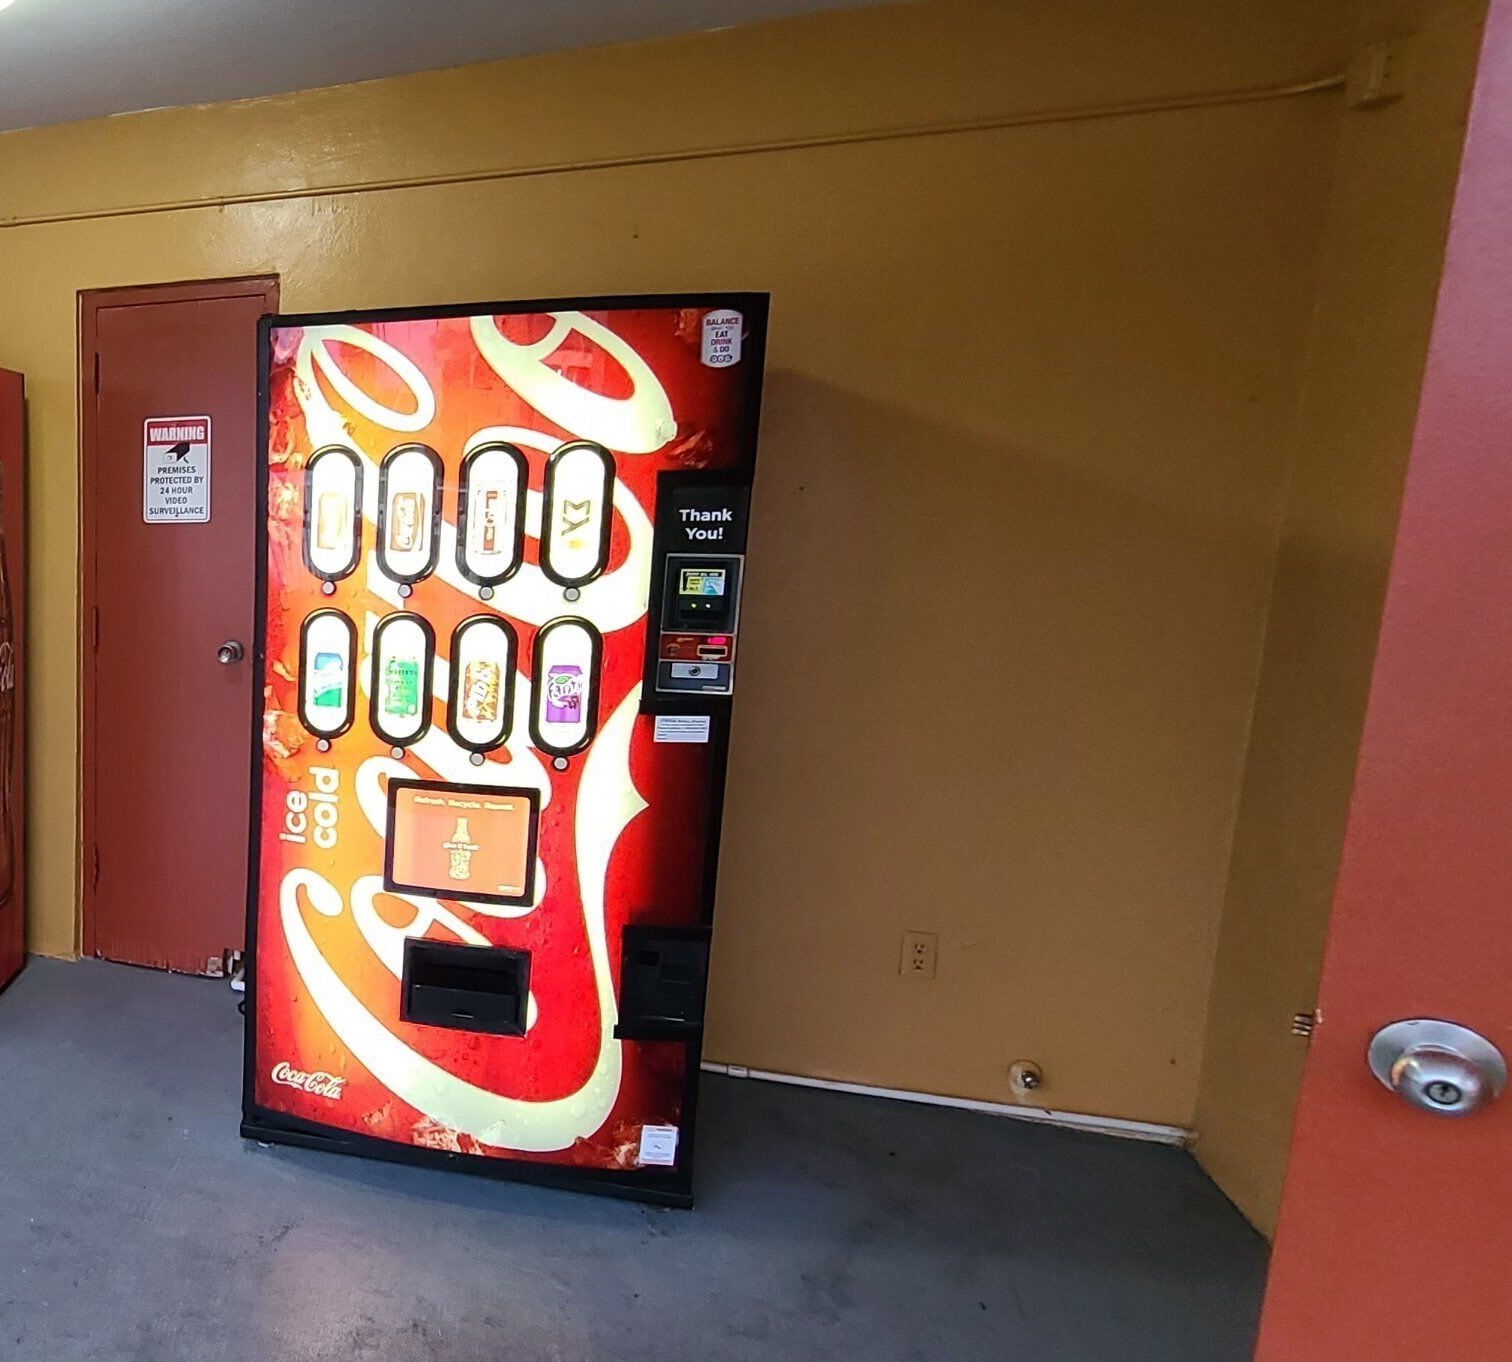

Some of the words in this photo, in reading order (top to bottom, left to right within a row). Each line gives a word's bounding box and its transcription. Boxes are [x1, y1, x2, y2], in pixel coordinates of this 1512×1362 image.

[706, 317, 739, 326] BALANCE
[149, 426, 205, 441] WARNING
[157, 466, 196, 474] PREMISES
[150, 477, 192, 485] PROTECTED
[194, 476, 204, 484] BY
[159, 487, 169, 495] 24
[171, 486, 193, 494] HOUR
[165, 496, 188, 504] VIDEO
[149, 506, 204, 515] SURVEILLANCE
[679, 508, 733, 522] Thank
[685, 527, 724, 540] You!
[308, 766, 340, 849] cold
[279, 790, 308, 844] ice
